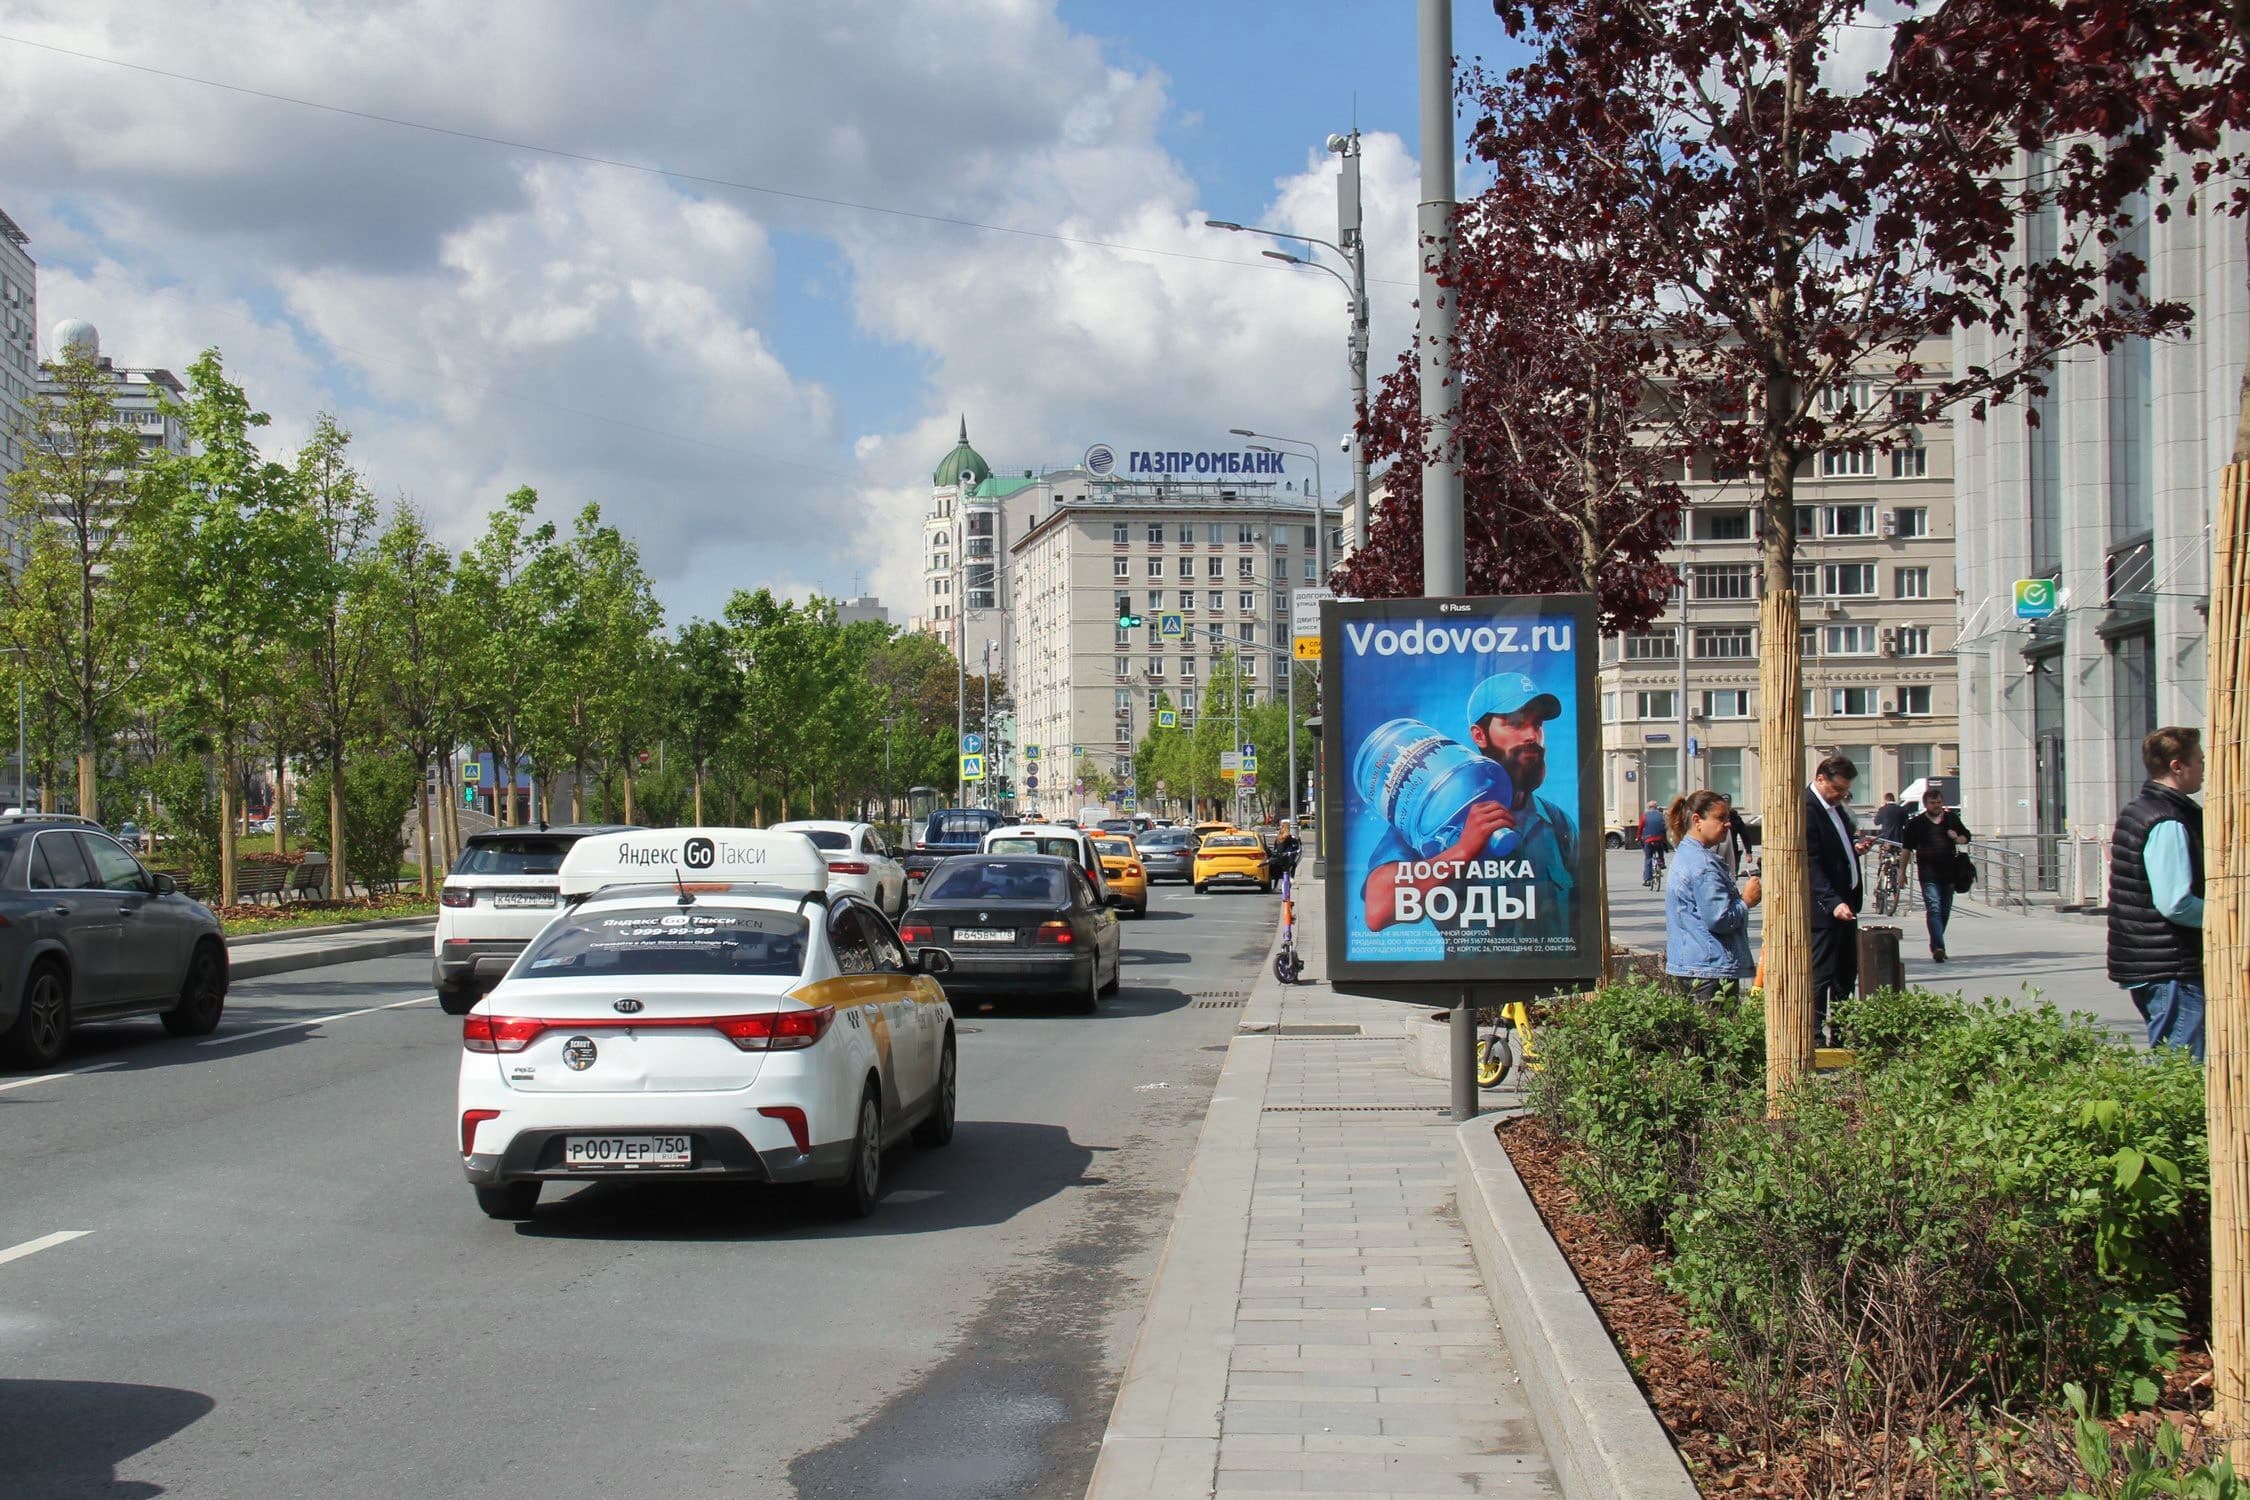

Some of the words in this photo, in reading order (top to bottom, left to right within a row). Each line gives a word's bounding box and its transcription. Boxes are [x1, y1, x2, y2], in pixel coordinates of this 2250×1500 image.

[1130, 452, 1284, 473] ГАЗПРОМБАНК
[1450, 604, 1471, 612] Russ
[1346, 619, 1570, 656] Vodovoz.ru
[618, 842, 679, 867] Яндекс
[687, 841, 712, 865] Go
[719, 842, 766, 865] Такси
[1394, 860, 1536, 884] ДОСТАВКА
[1394, 885, 1536, 928] ВОДЫ
[602, 918, 659, 927] Яндекс
[692, 916, 737, 925] Такси
[632, 927, 715, 936] 999-99-99
[616, 1000, 639, 1011] KIA
[572, 1139, 650, 1160] Р007ЕР
[654, 1138, 685, 1153] 750
